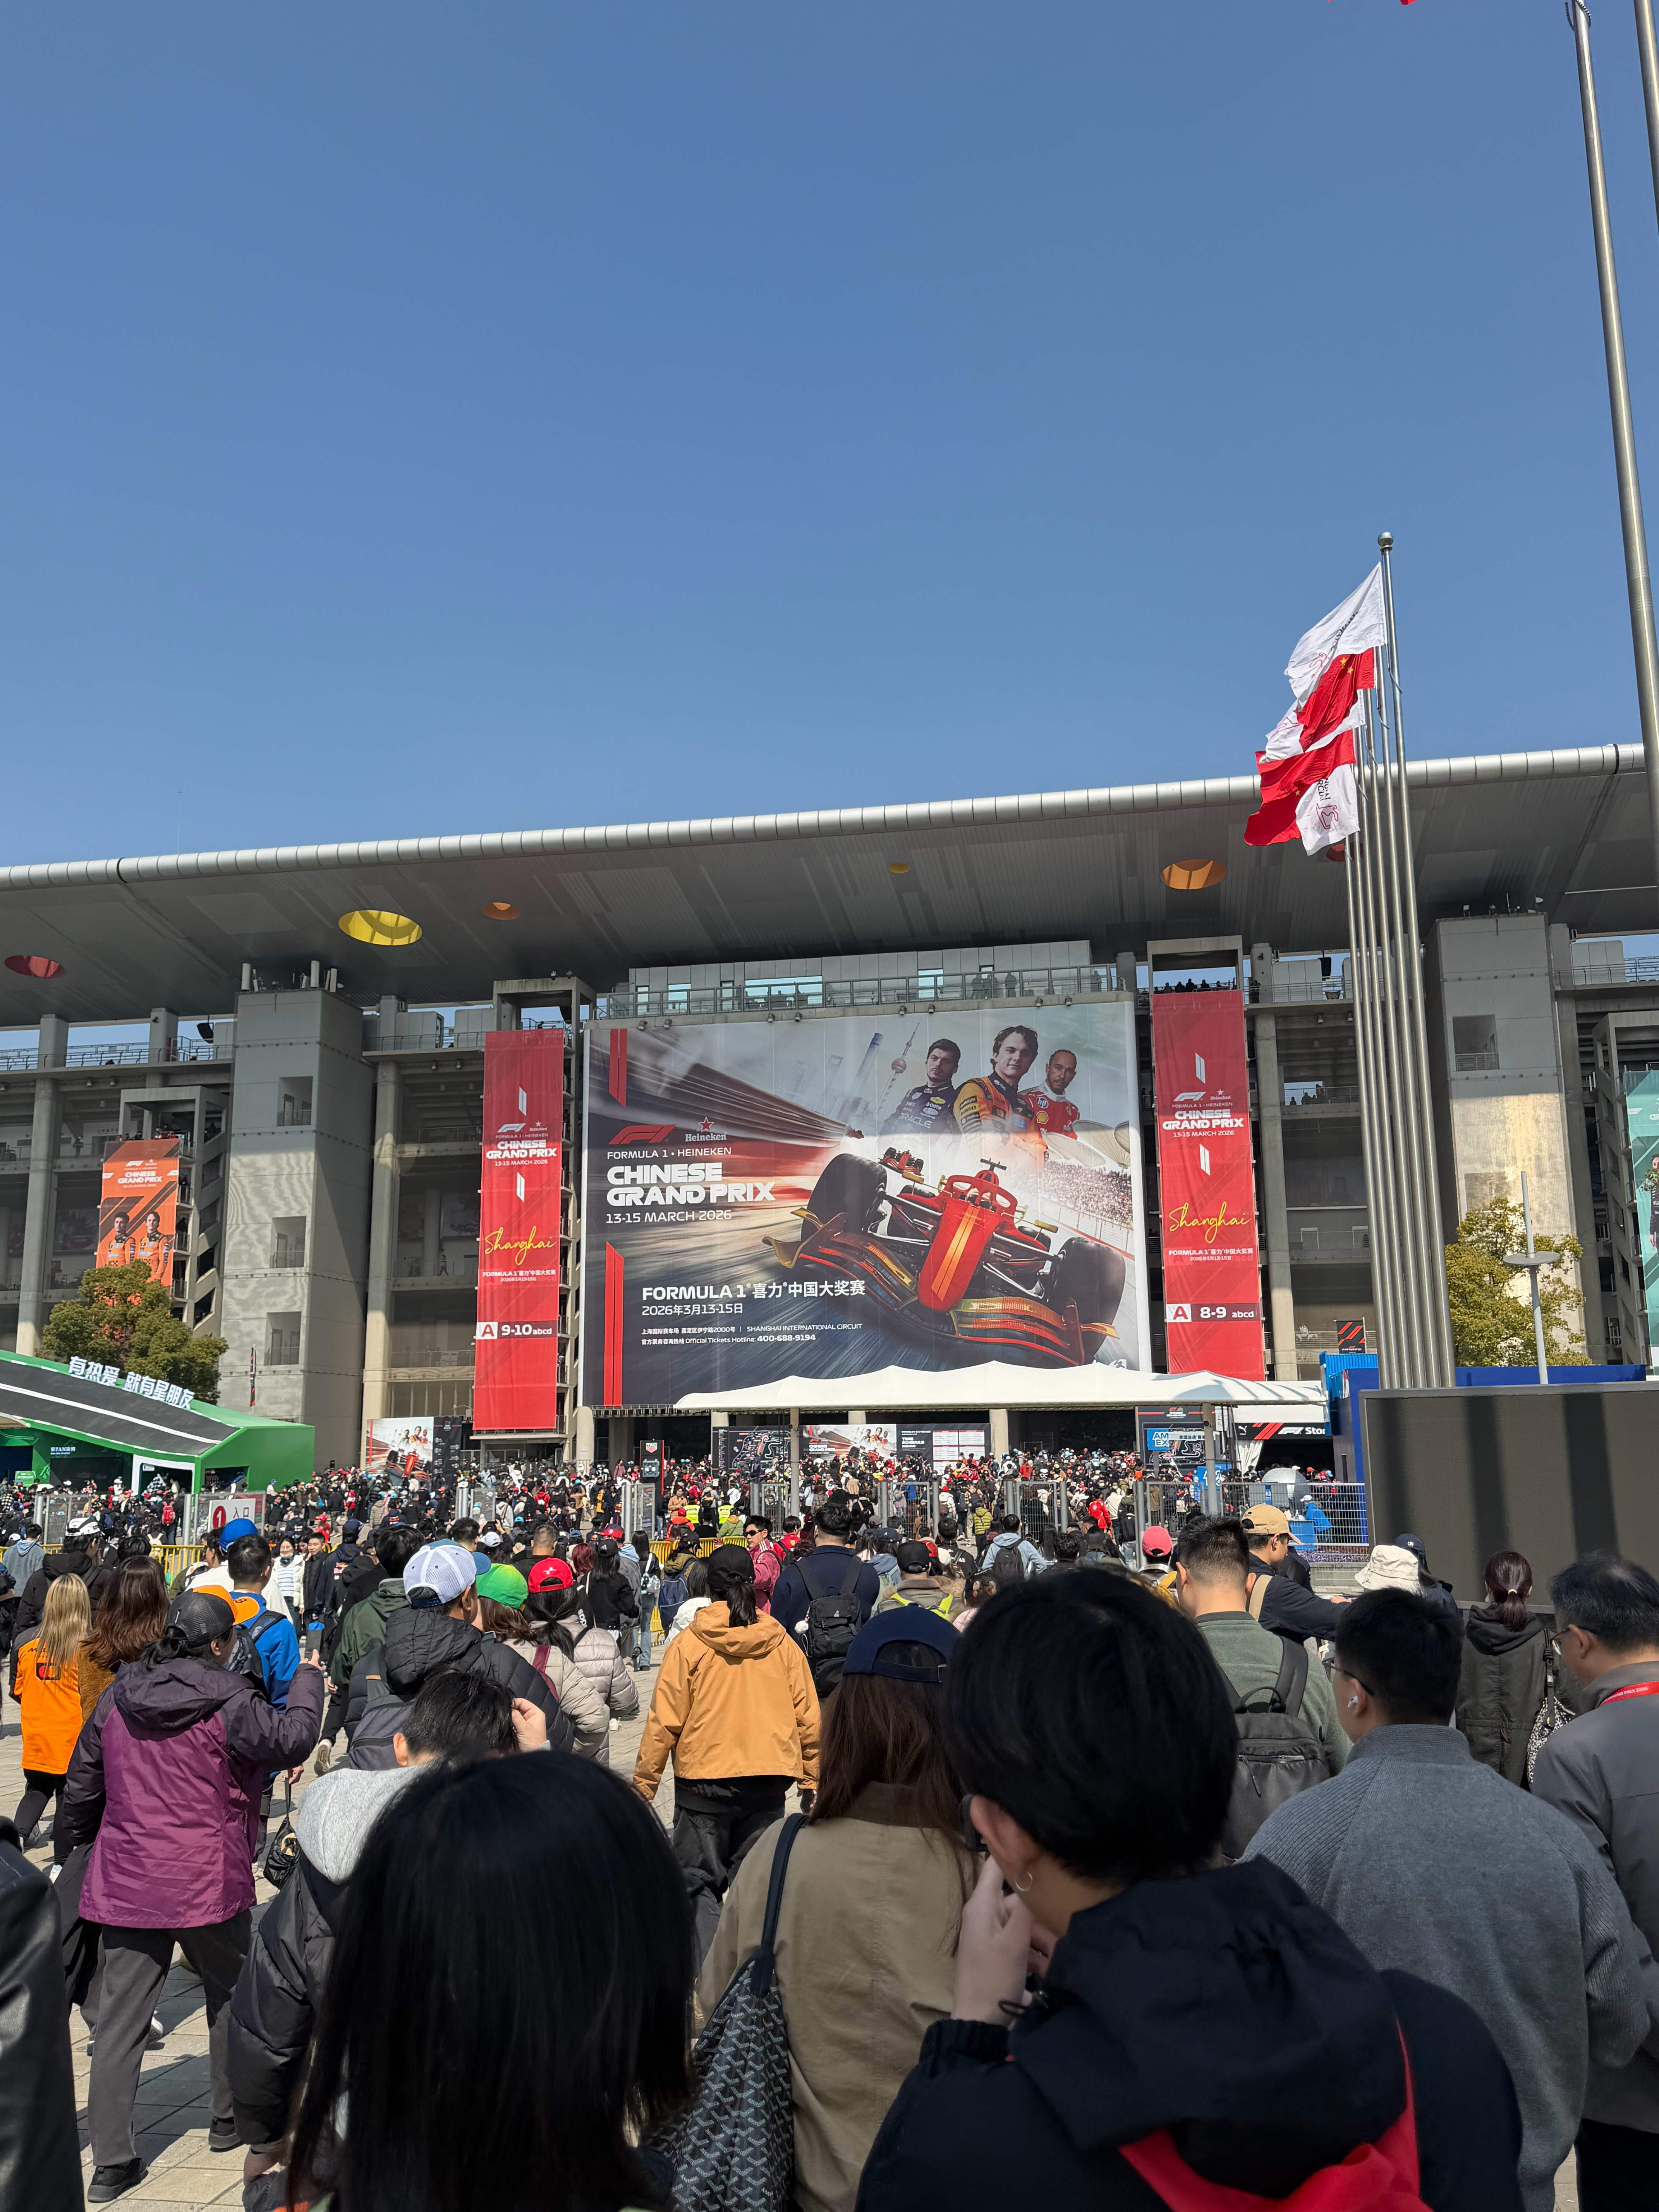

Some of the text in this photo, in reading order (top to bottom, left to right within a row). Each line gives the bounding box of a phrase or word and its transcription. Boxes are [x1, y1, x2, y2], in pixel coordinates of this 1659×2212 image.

[1173, 1092, 1206, 1101] F1
[900, 1113, 933, 1128] ORACLE
[1175, 1109, 1231, 1120] CHINESE
[497, 1123, 526, 1133] F1
[1162, 1118, 1244, 1130] GRAND PRIX
[608, 1124, 676, 1145] F1
[685, 1133, 727, 1142] Heineken
[497, 1140, 546, 1149] CHINESE
[486, 1148, 557, 1159] GRAND PRIX
[607, 1147, 732, 1160] FORMULA 1 HEINEKEN
[607, 1162, 722, 1185] CHINESE
[606, 1182, 776, 1206] GRAND PRIX
[606, 1209, 732, 1224] 13-15 MARCH 2026
[1169, 1201, 1252, 1244] Shanghai
[485, 1226, 556, 1266] Shanghai
[642, 1285, 733, 1300] FORMULA
[642, 1303, 743, 1316] 2026年3月13-15日
[1173, 1306, 1188, 1320] A
[1200, 1307, 1226, 1318] 8-9
[481, 1324, 495, 1337] A
[69, 1356, 195, 1410] 有热爱 就有星朋友
[1152, 1431, 1169, 1440] AM
[233, 1507, 249, 1518] 入口
